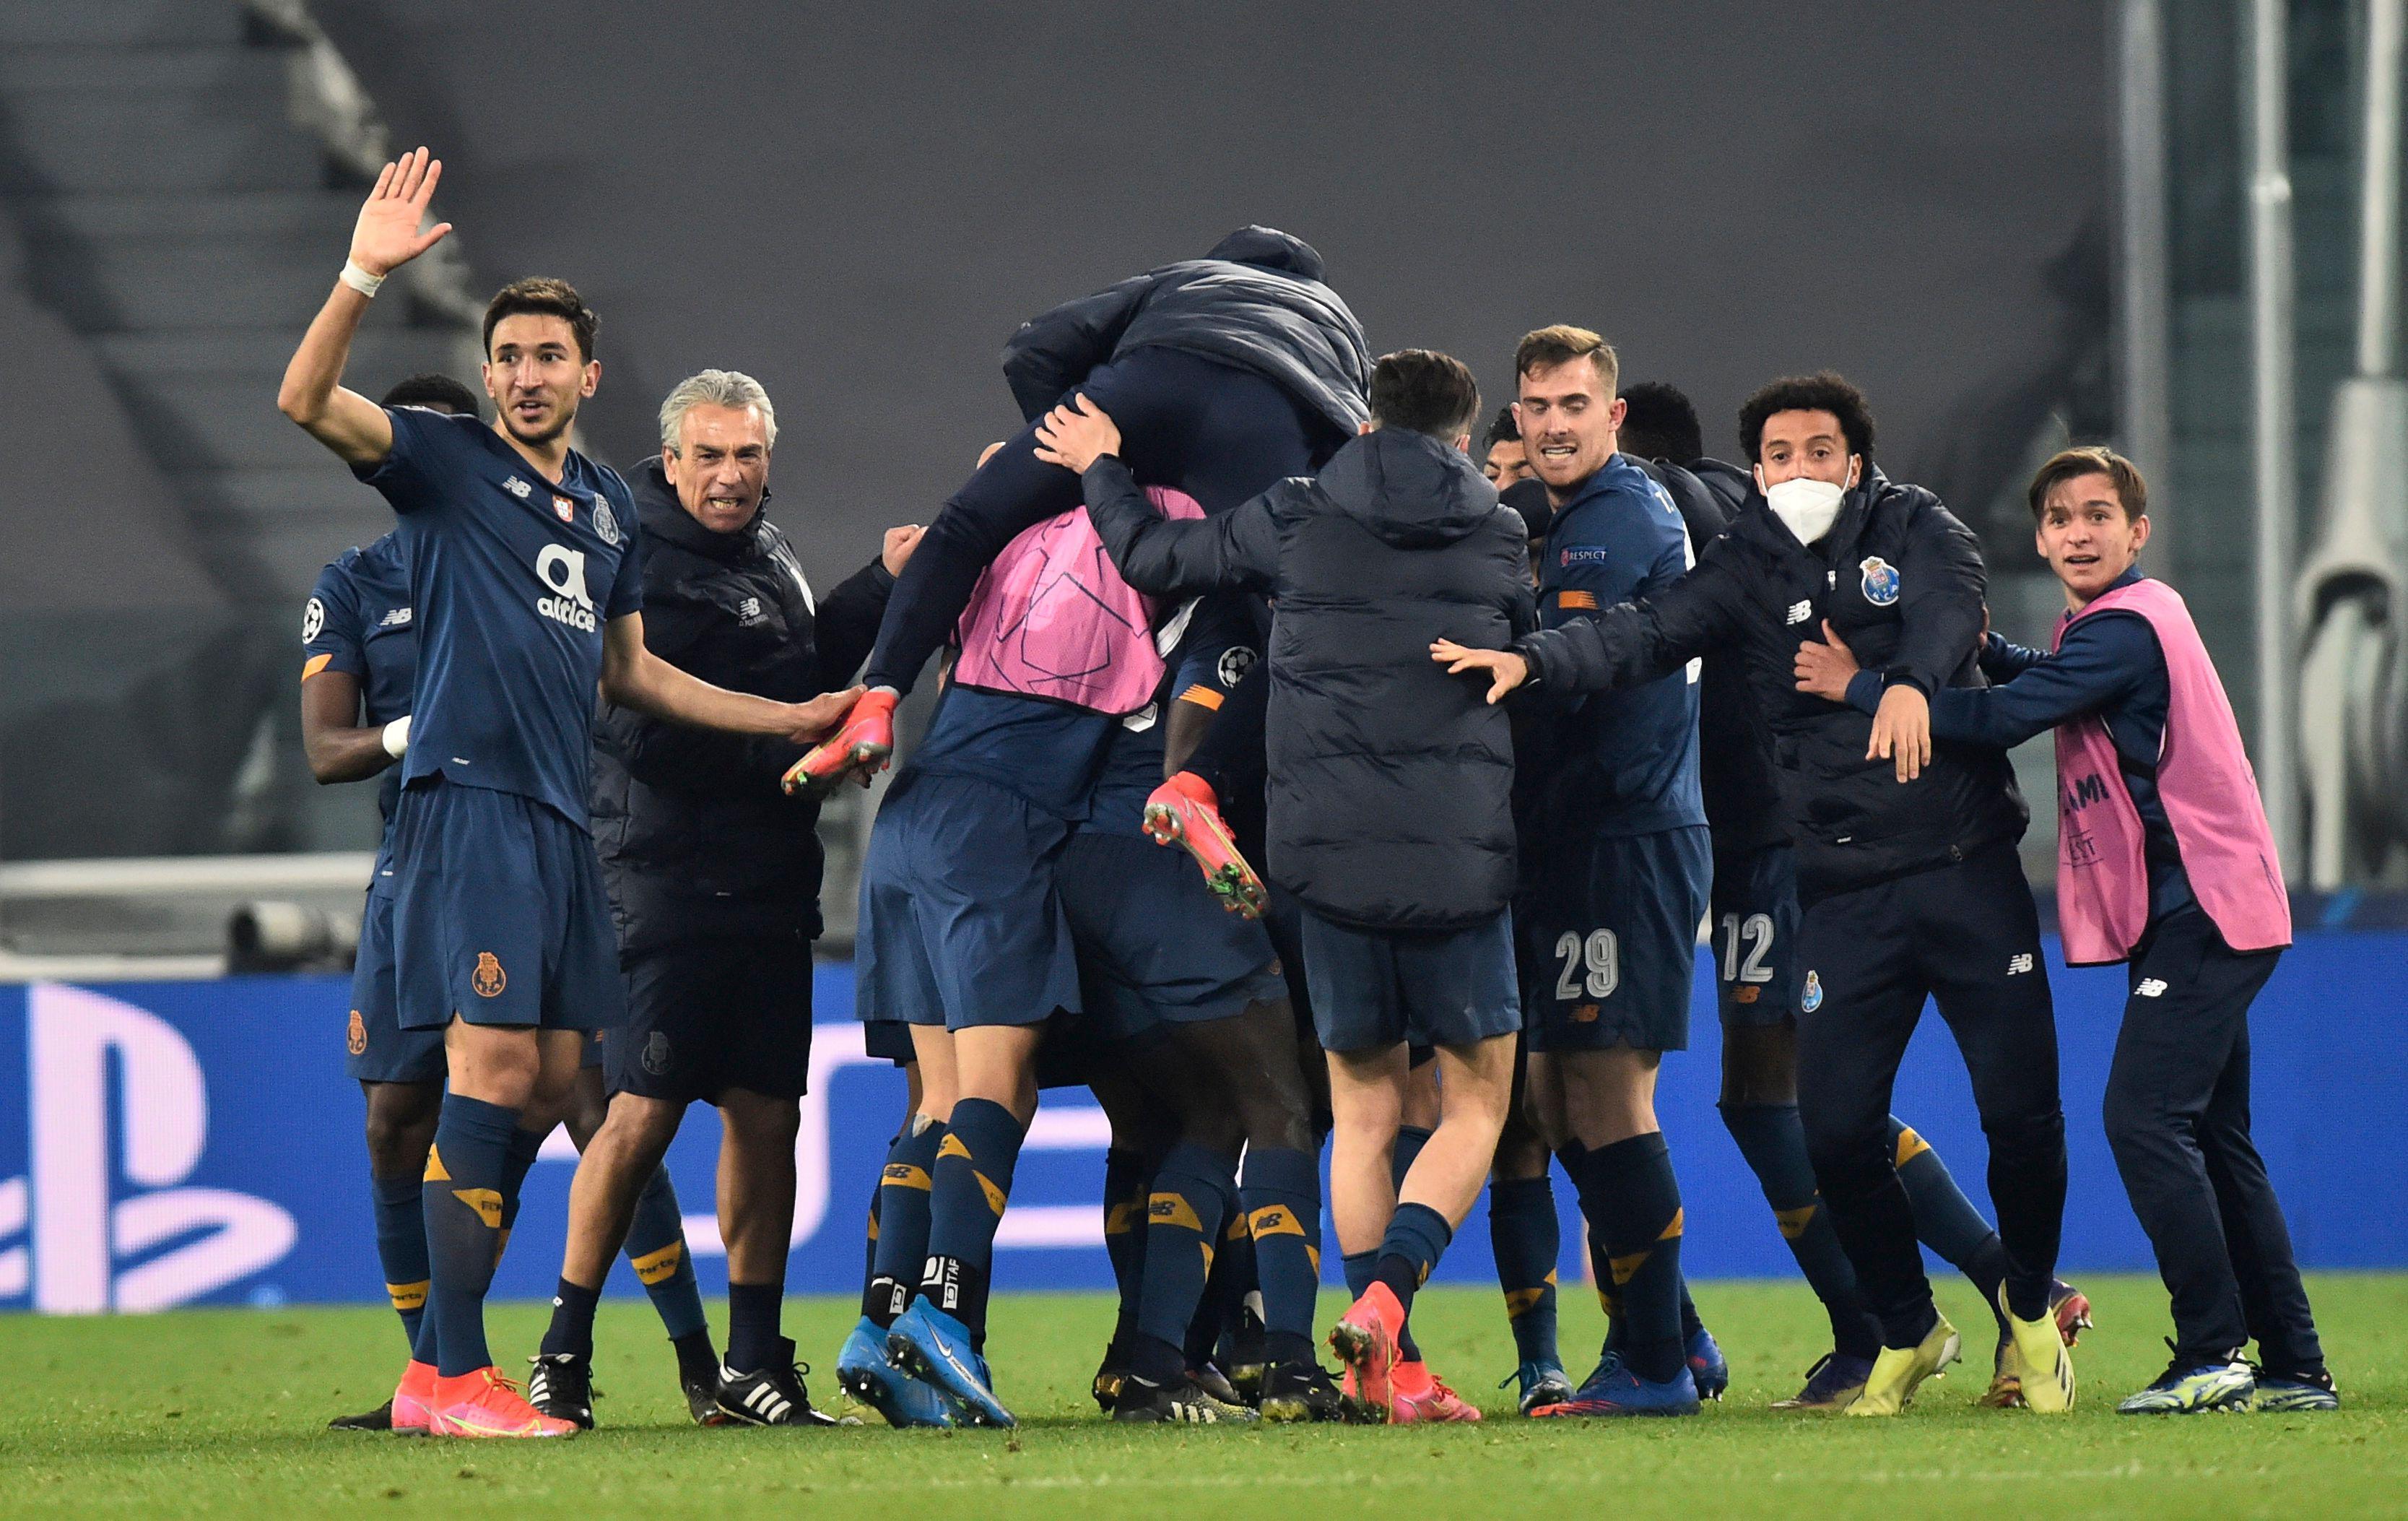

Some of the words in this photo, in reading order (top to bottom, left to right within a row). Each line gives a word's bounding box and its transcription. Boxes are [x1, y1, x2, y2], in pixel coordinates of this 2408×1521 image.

[1569, 550, 1607, 561] RESPECT
[536, 596, 596, 633] altice
[1555, 928, 1619, 1000] 29
[1723, 913, 1774, 982] 12
